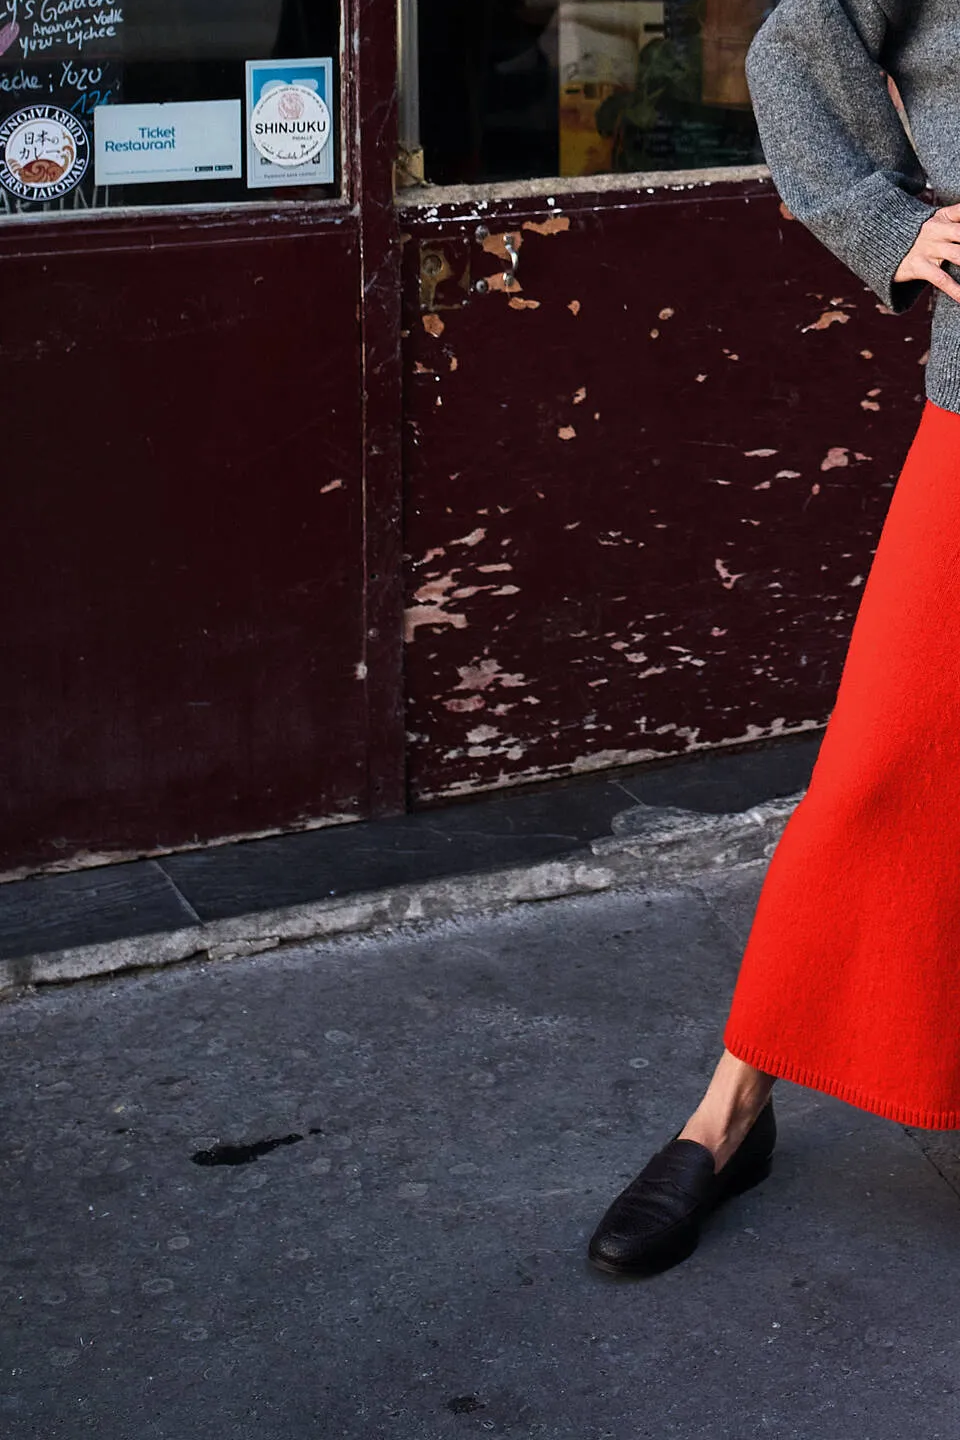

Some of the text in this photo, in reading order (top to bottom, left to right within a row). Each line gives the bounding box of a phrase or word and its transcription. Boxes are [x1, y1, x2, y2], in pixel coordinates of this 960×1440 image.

[138, 126, 176, 139] Ticket
[255, 121, 326, 135] SHINJUKU
[104, 139, 176, 153] Restaurant
